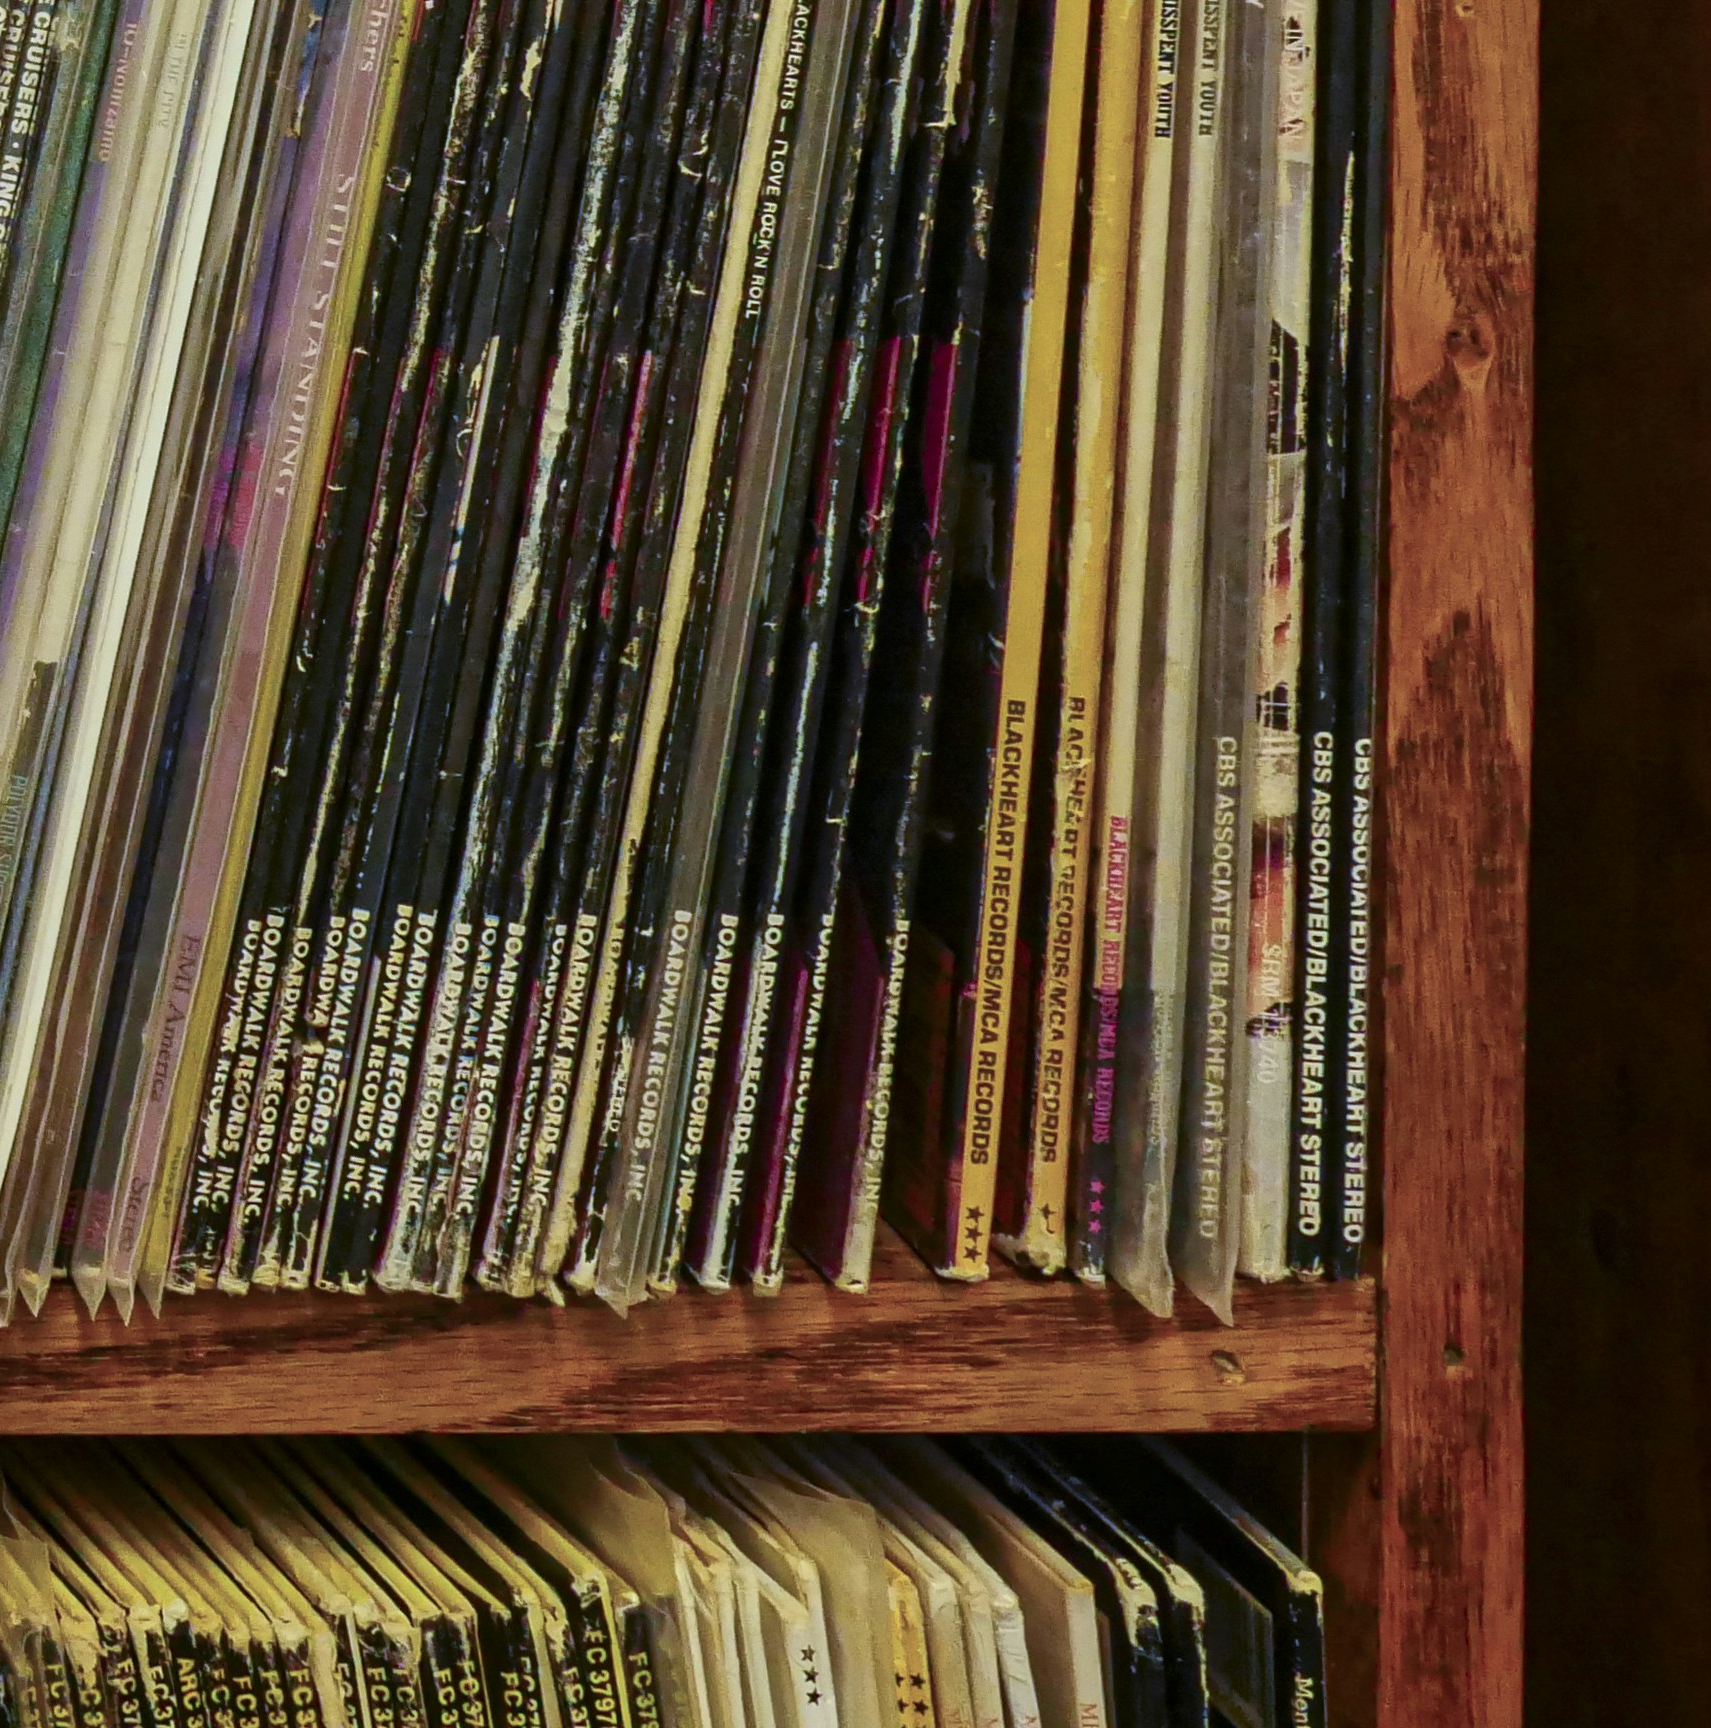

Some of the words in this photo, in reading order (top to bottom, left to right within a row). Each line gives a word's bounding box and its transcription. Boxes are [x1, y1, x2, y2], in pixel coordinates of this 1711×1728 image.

[993, 699, 1025, 861] BLACKHEART
[1311, 731, 1333, 782] CBS
[371, 903, 413, 1040] BOARDWALK
[979, 865, 1012, 1046] RECORDS/MCA
[1300, 789, 1331, 1128] ASSOCIATED/BLACKHEART
[351, 1043, 388, 1151] RECORDS,
[969, 1050, 997, 1166] RECORDS
[342, 1156, 367, 1201] INC.
[1297, 1133, 1321, 1235] STEREO
